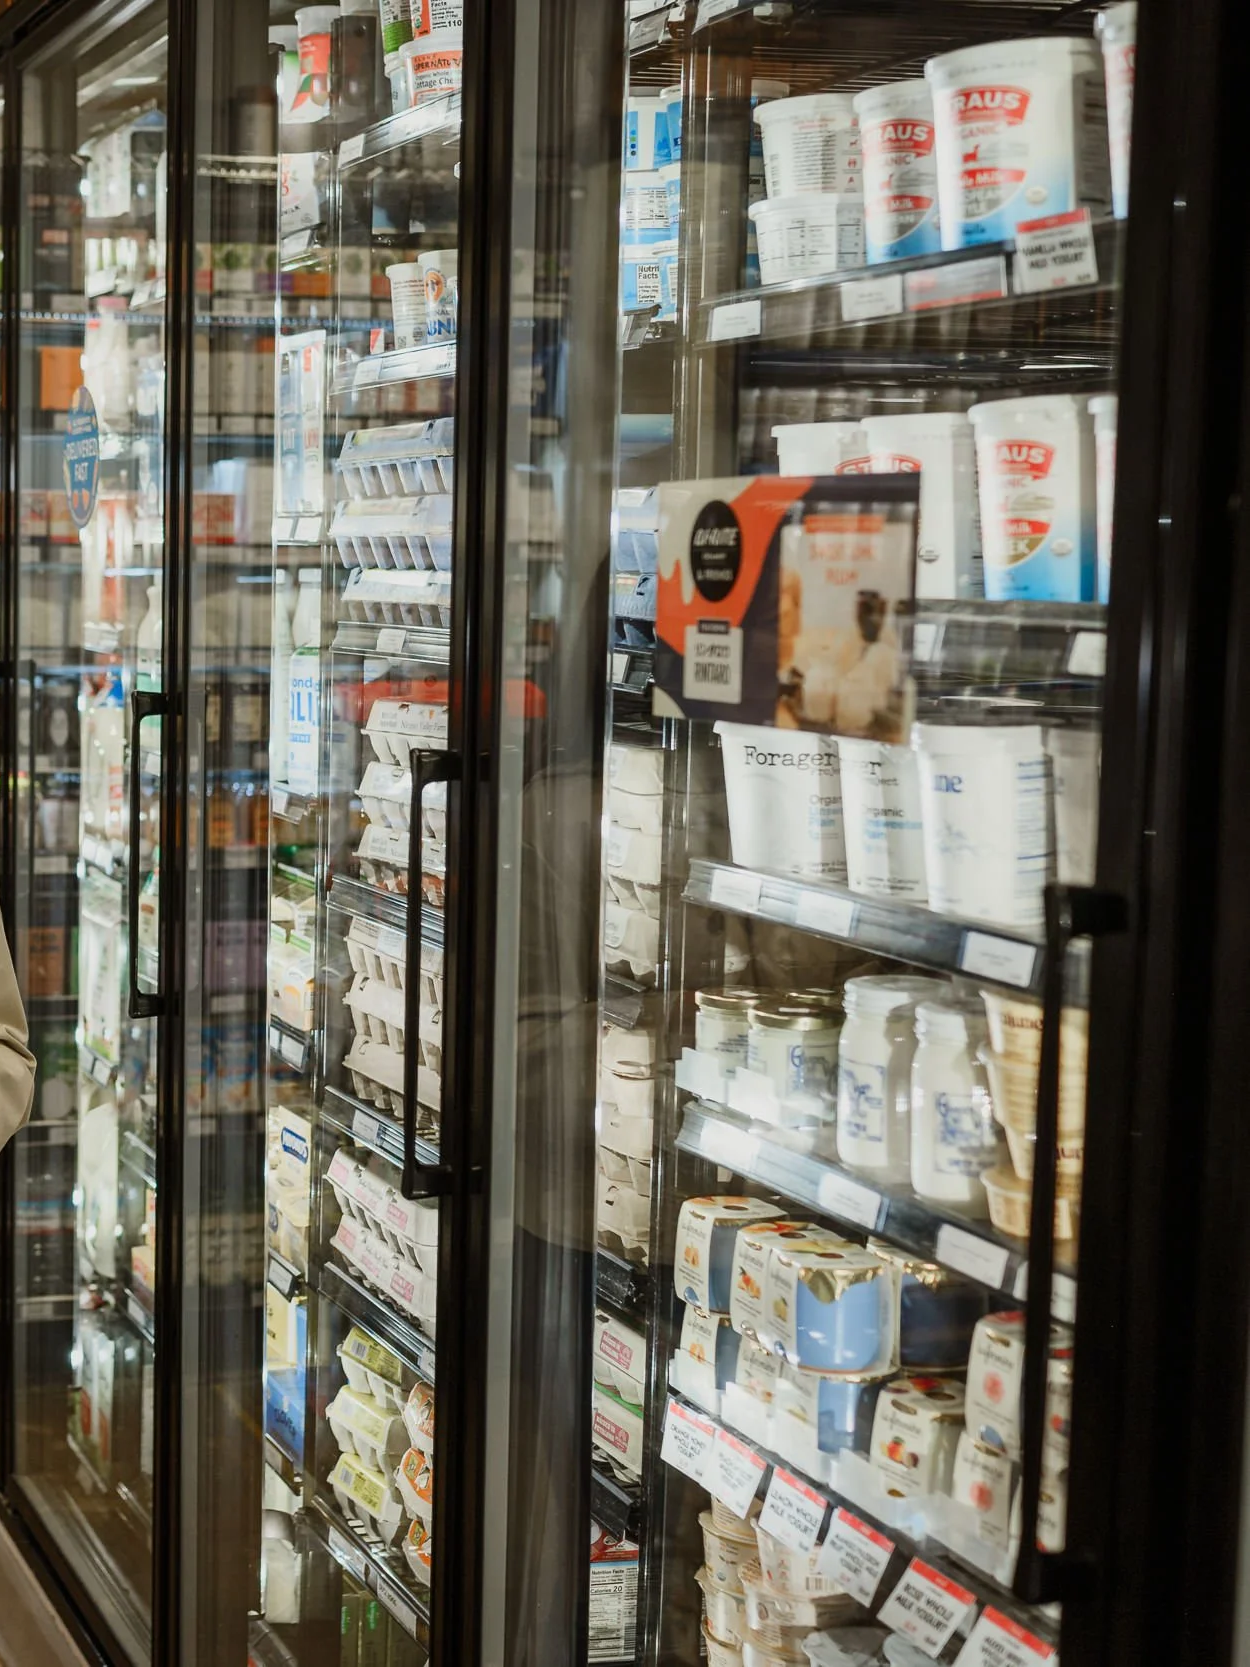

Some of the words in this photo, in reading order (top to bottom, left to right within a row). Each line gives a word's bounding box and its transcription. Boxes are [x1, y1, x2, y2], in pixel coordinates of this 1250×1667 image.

[447, 19, 462, 27] 110
[638, 272, 659, 280] Facts
[743, 745, 838, 770] Forager
[769, 1503, 786, 1519] MILK
[787, 1515, 814, 1537] YOGURT
[770, 1488, 795, 1507] LEMON
[795, 1506, 820, 1527] WHOLE
[895, 1595, 915, 1613] MILK
[915, 1606, 949, 1633] YOGURT
[903, 1583, 924, 1600] ROSE
[924, 1596, 955, 1620] WHOLE
